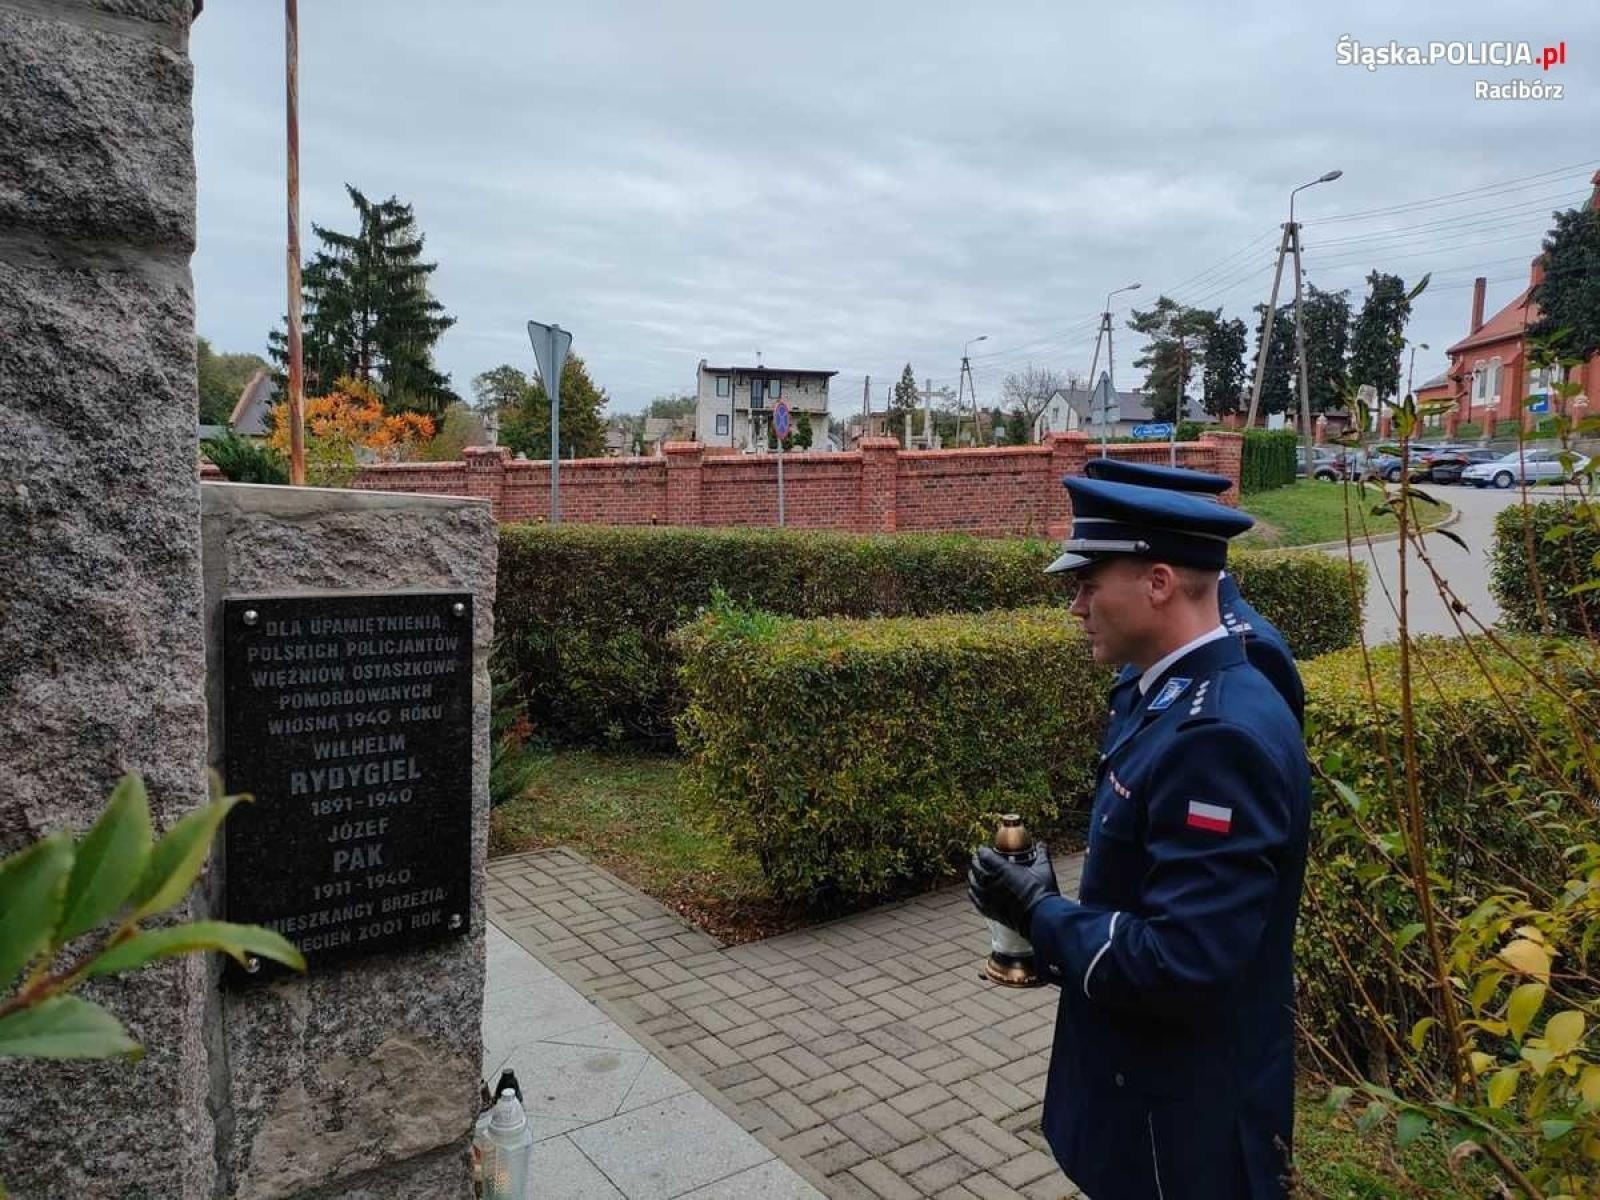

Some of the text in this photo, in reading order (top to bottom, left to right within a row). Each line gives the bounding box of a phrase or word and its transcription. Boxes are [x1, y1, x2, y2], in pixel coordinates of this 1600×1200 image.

[266, 615, 441, 637] DLA UPAMIĘTNIENIA
[247, 643, 338, 662] POLSKICH
[352, 659, 456, 681] OSTASZKOWA
[279, 683, 432, 710] POMORDOWANYCH
[347, 708, 391, 728] 1940
[400, 704, 442, 723] ROKU
[313, 734, 406, 760] WILHELM
[291, 757, 422, 795] RYDYGIEL
[328, 817, 389, 843] JÓZEF
[333, 843, 383, 873] PAK
[411, 909, 442, 929] ROK
